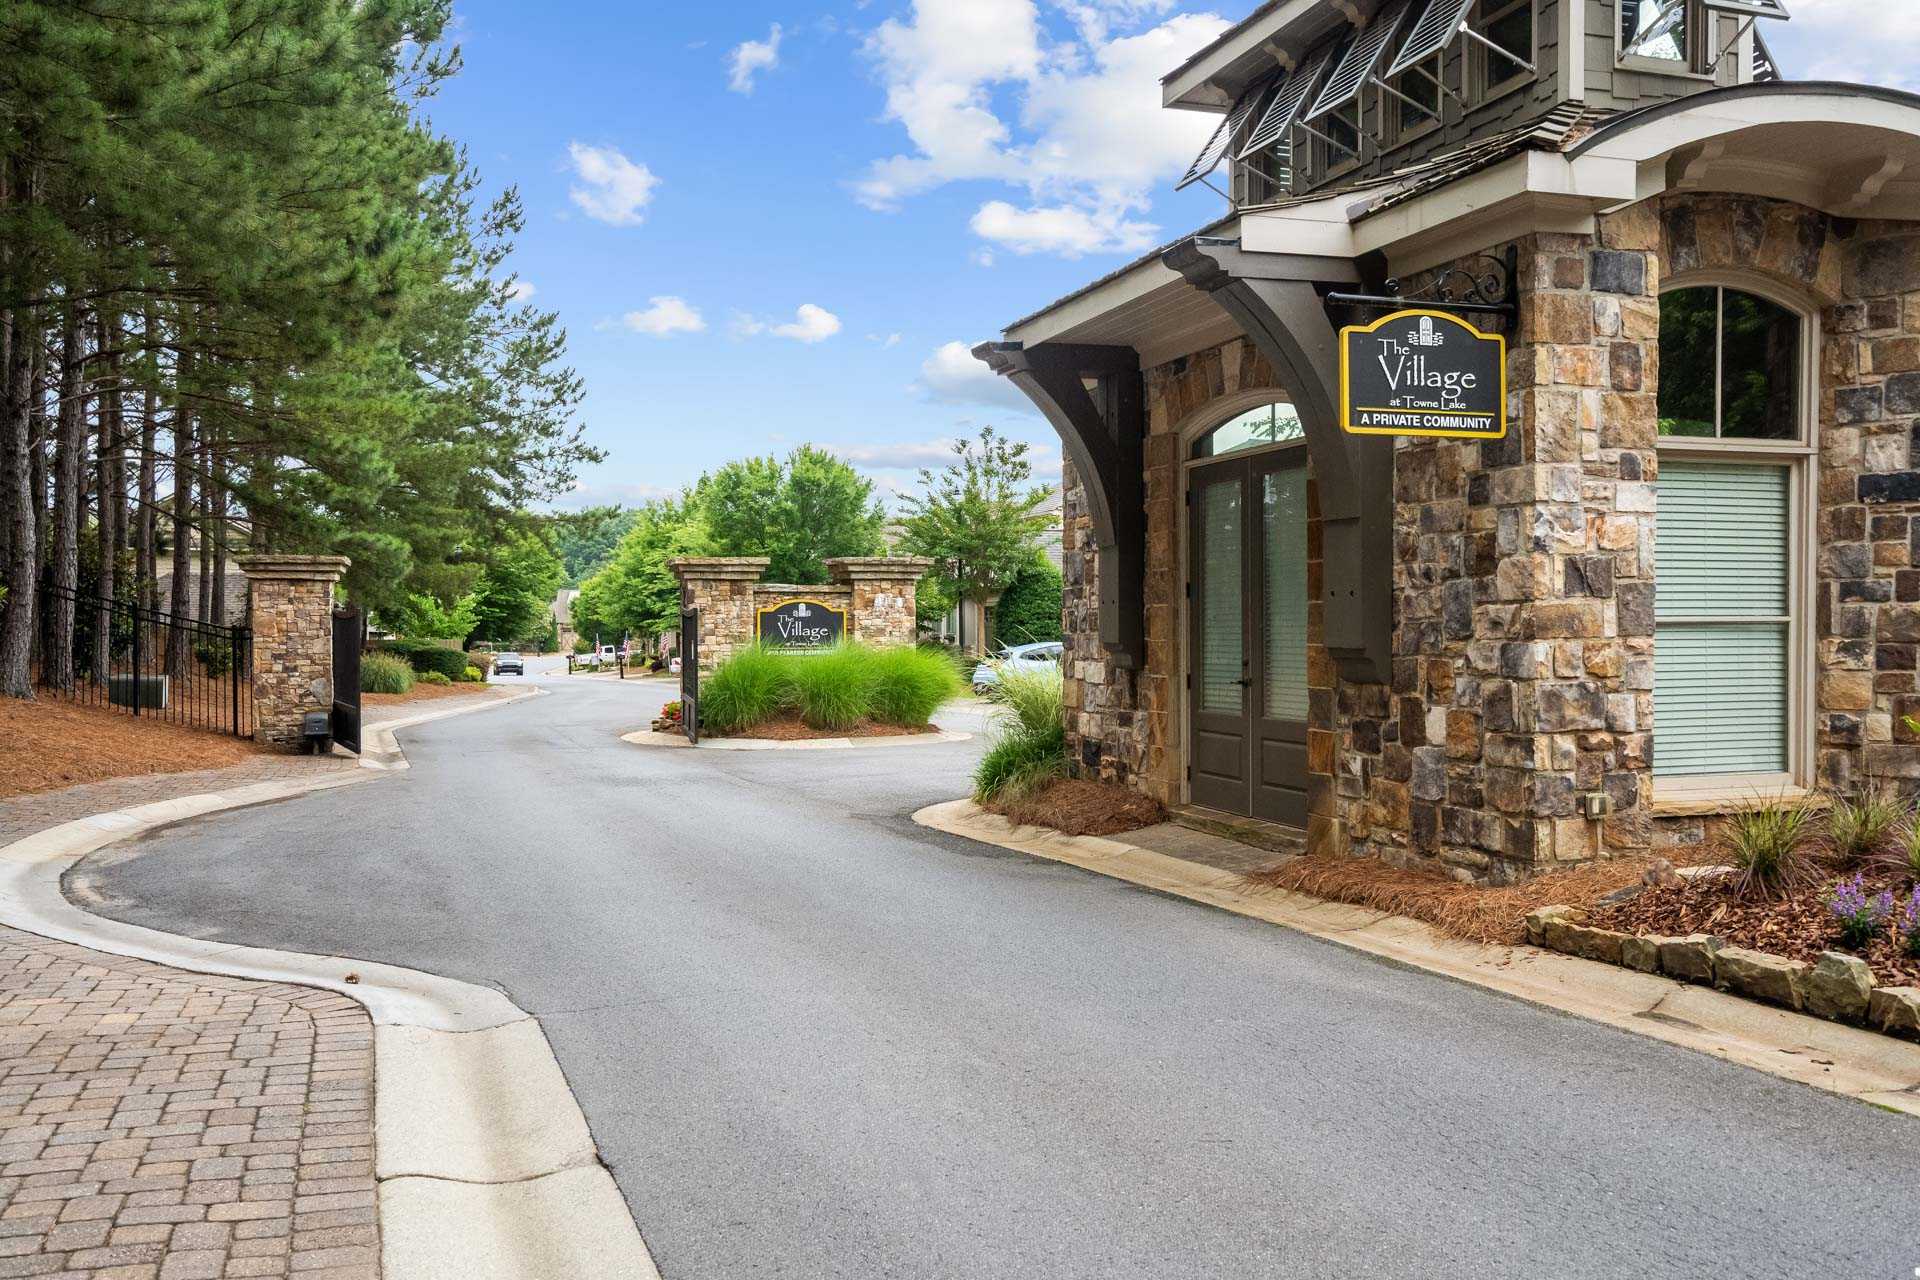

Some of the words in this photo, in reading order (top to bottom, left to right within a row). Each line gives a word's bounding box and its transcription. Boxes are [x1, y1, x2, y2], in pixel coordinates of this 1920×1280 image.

[1377, 338, 1410, 356] The
[1378, 355, 1476, 398] Village
[1402, 396, 1438, 409] Towne
[1441, 397, 1466, 410] Lake
[1361, 414, 1370, 424] A
[1373, 414, 1421, 426] PRIVATE
[1423, 416, 1491, 429] COMMUNITY
[777, 614, 795, 623] The
[777, 621, 829, 640] Village
